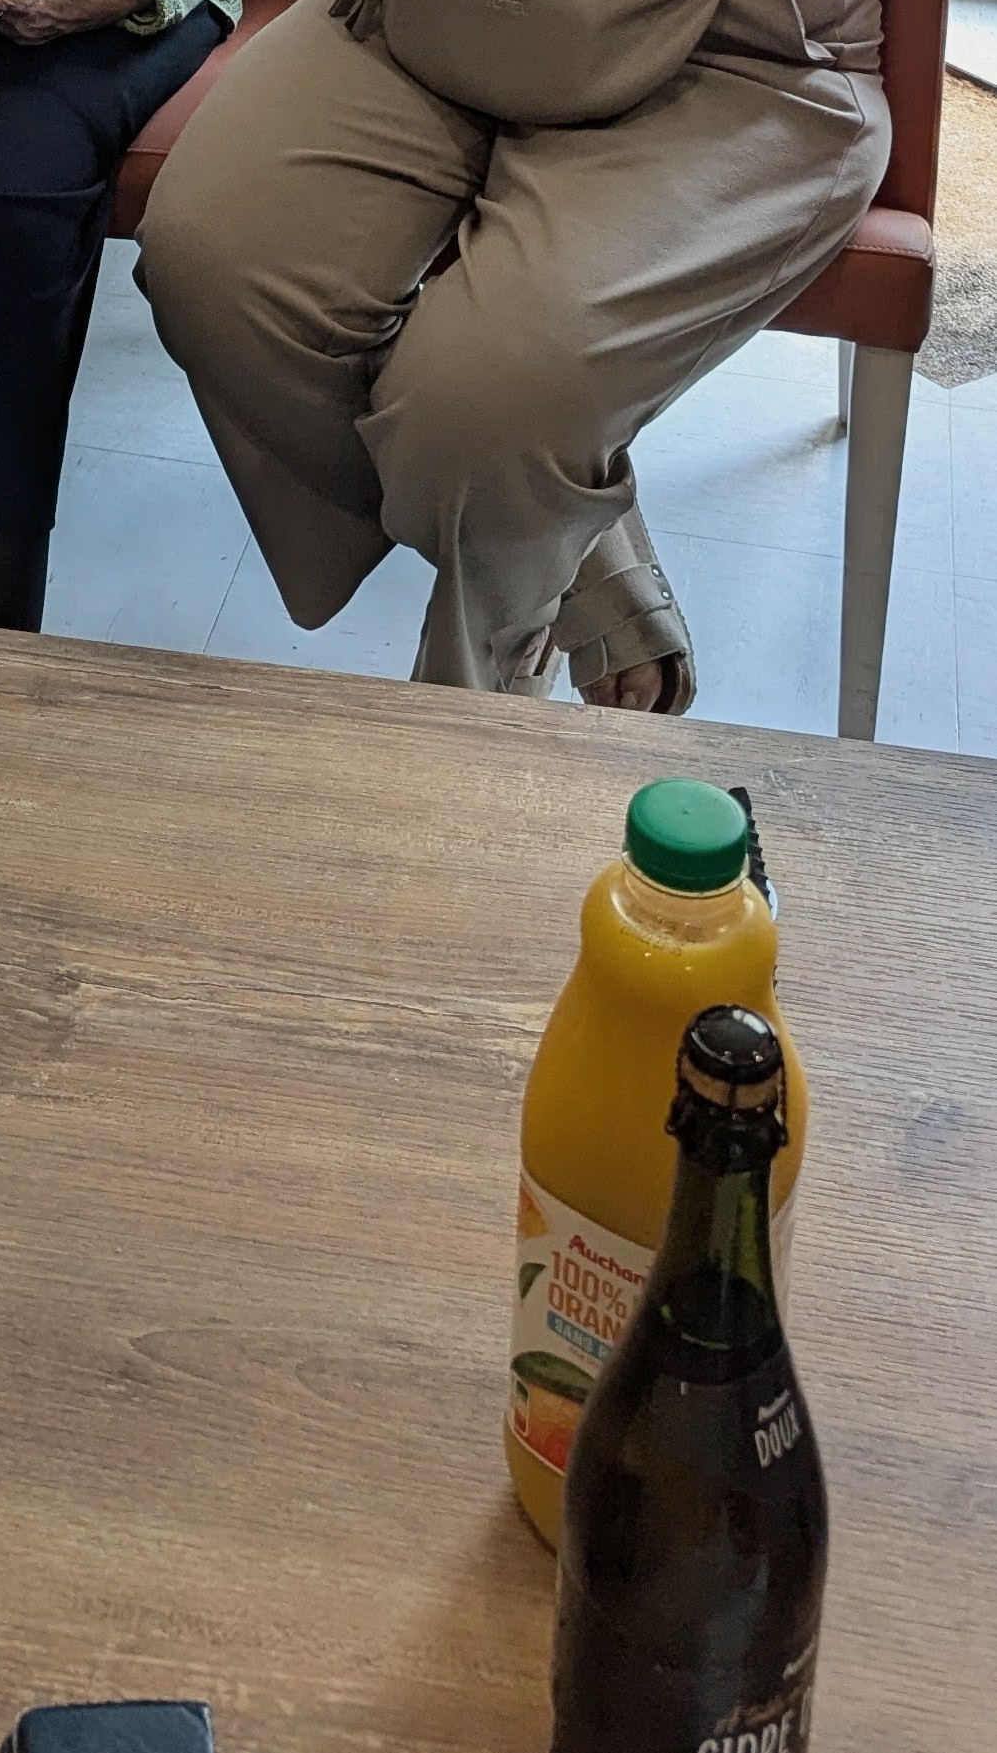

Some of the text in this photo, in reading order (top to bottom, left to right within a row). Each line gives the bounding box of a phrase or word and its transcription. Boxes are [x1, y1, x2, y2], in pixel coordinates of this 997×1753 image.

[551, 1251, 628, 1320] 100%
[568, 1234, 645, 1286] Auchan
[754, 1401, 802, 1468] DOUX
